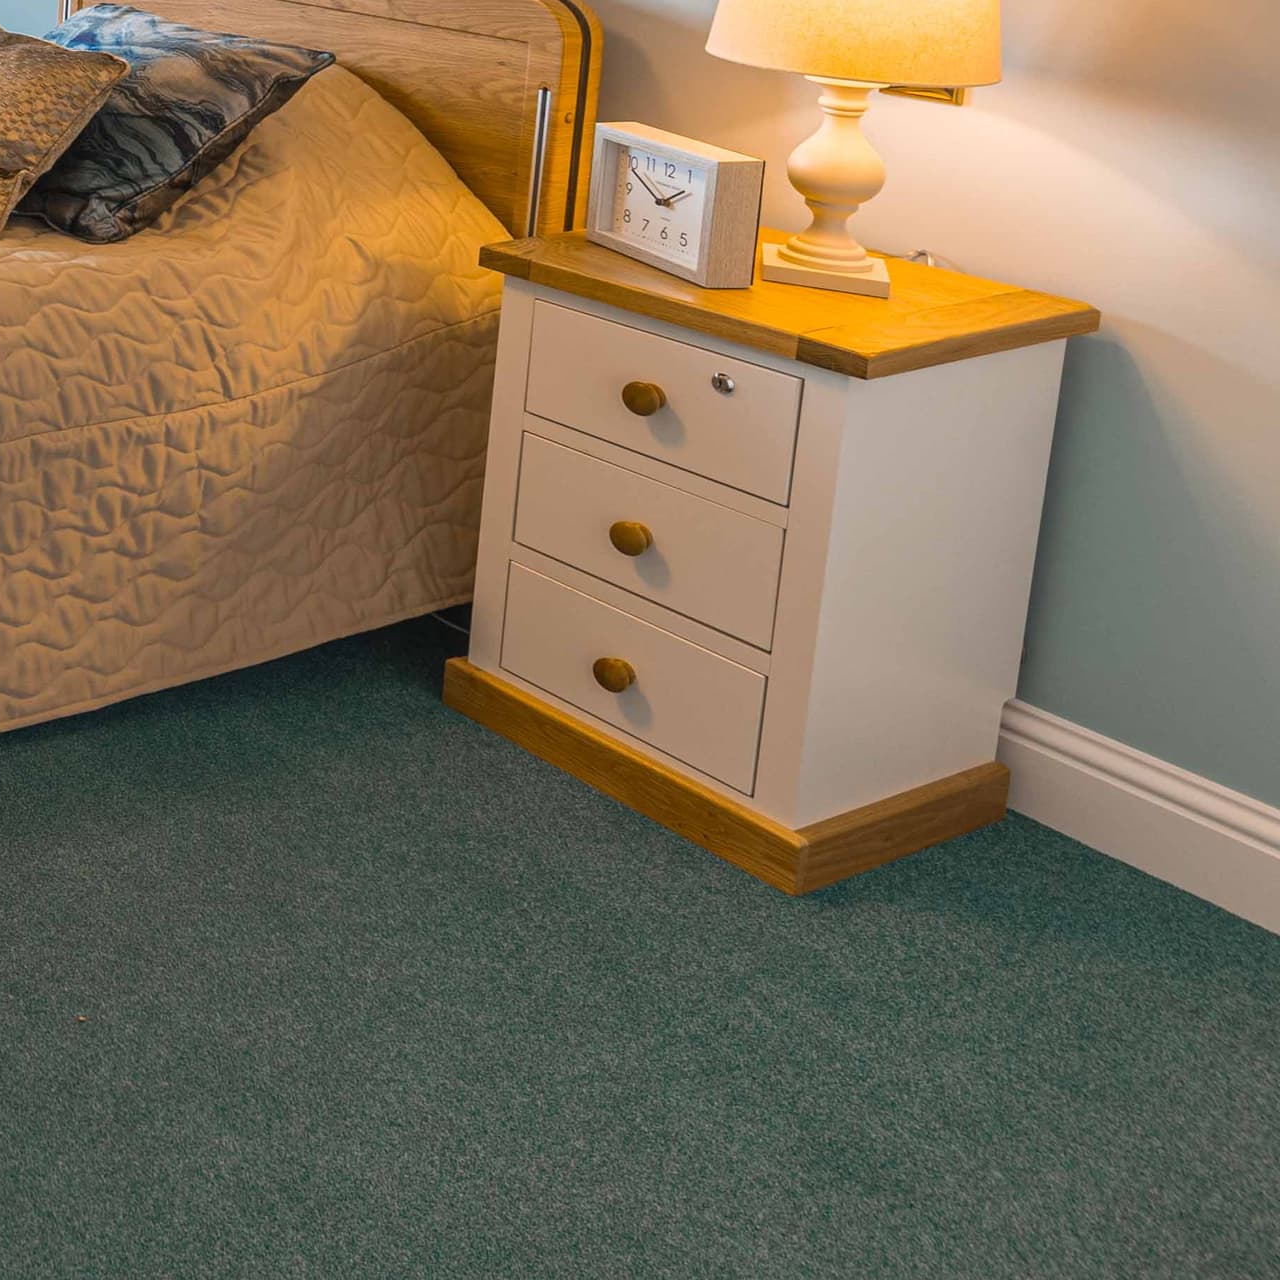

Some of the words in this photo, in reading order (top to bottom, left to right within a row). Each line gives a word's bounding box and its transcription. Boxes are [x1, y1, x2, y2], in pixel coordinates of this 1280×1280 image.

[627, 154, 638, 170] 10
[646, 156, 656, 172] 11
[664, 162, 676, 178] 12
[688, 169, 692, 184] 1
[625, 182, 632, 195] 9
[623, 209, 631, 223] 8
[642, 218, 650, 231] 7
[660, 226, 668, 240] 6
[679, 232, 688, 247] 5
